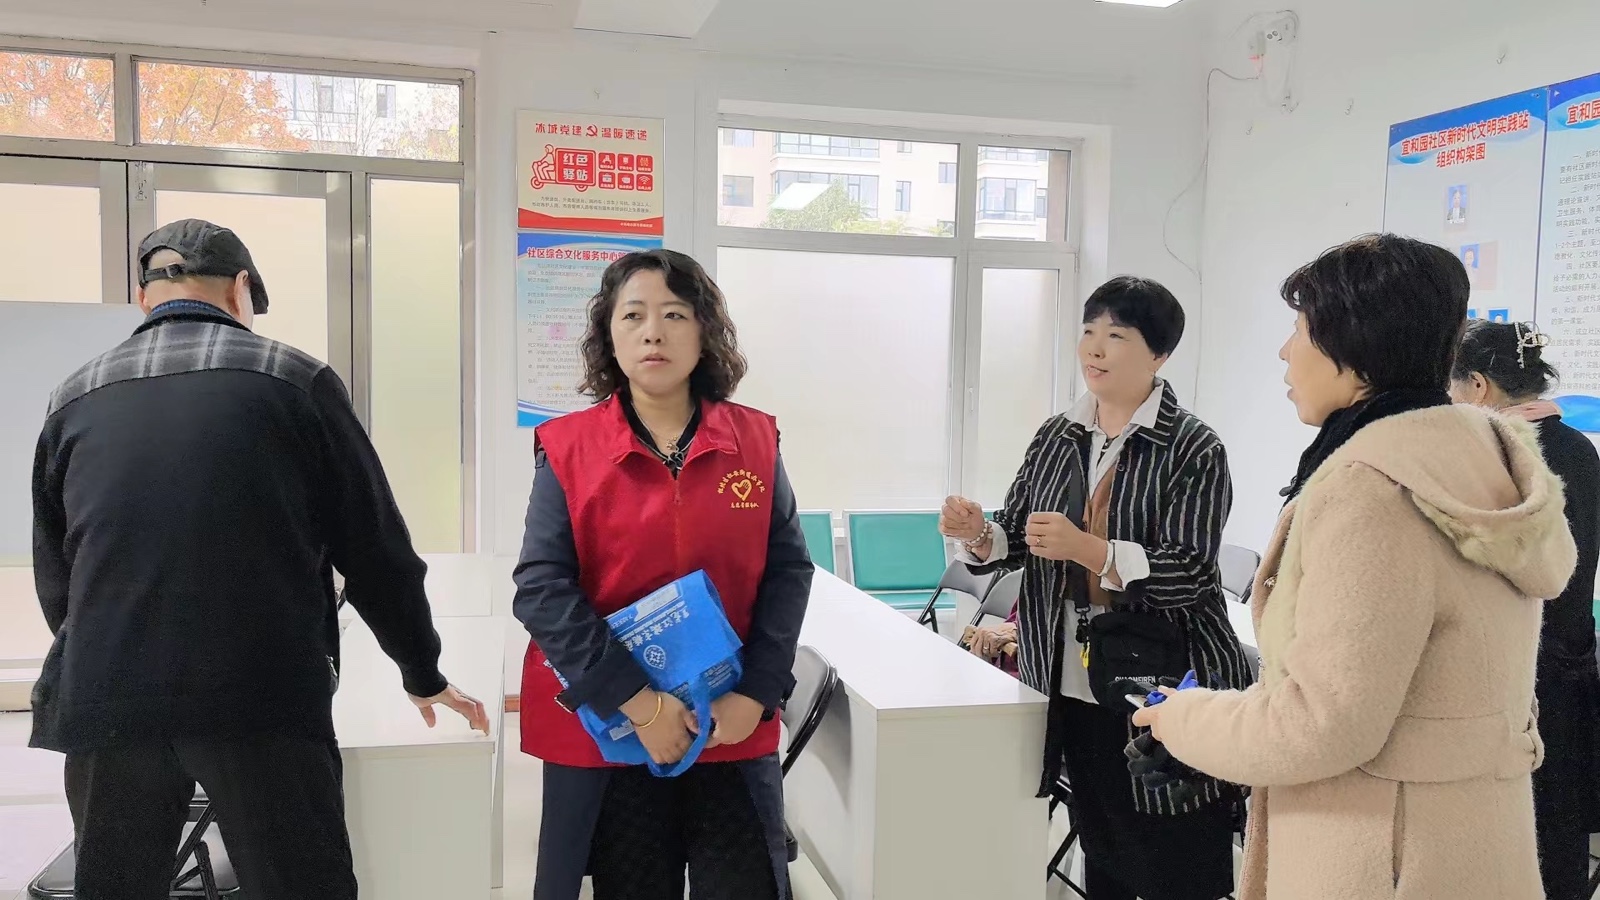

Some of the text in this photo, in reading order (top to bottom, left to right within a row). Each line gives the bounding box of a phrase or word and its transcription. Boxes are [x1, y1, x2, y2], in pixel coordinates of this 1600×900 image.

[1567, 99, 1600, 124] 宜和园
[535, 122, 648, 141] 冰城党建 温暖速递
[1401, 111, 1530, 156] 宜和园社区新时代文明实践站
[562, 153, 588, 167] 红色
[1436, 142, 1486, 168] 组织构架图
[562, 168, 588, 181] 驿站
